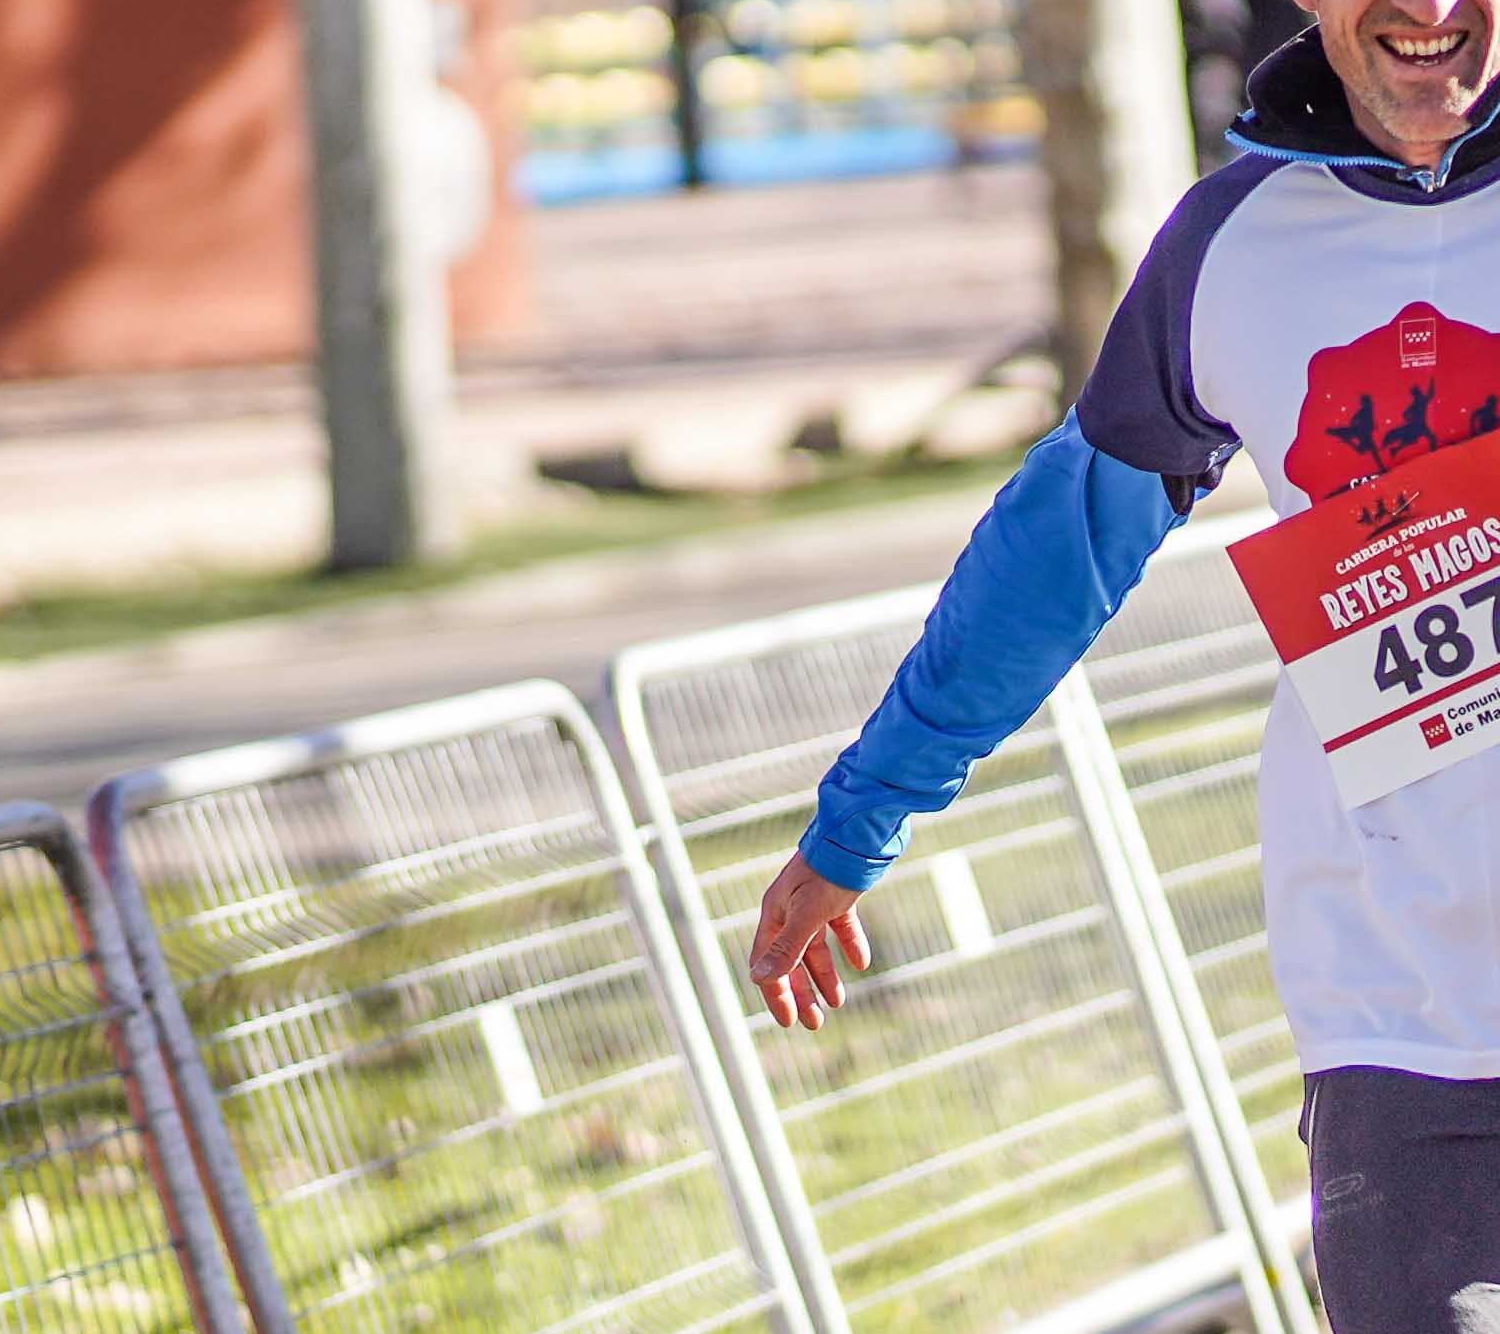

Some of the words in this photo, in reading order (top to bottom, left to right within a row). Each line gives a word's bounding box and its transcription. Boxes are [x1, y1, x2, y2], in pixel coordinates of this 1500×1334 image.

[1335, 535, 1399, 575] CARRERA
[1399, 508, 1467, 542] POPULAR
[1319, 564, 1409, 631] REYES
[1454, 722, 1474, 737] de
